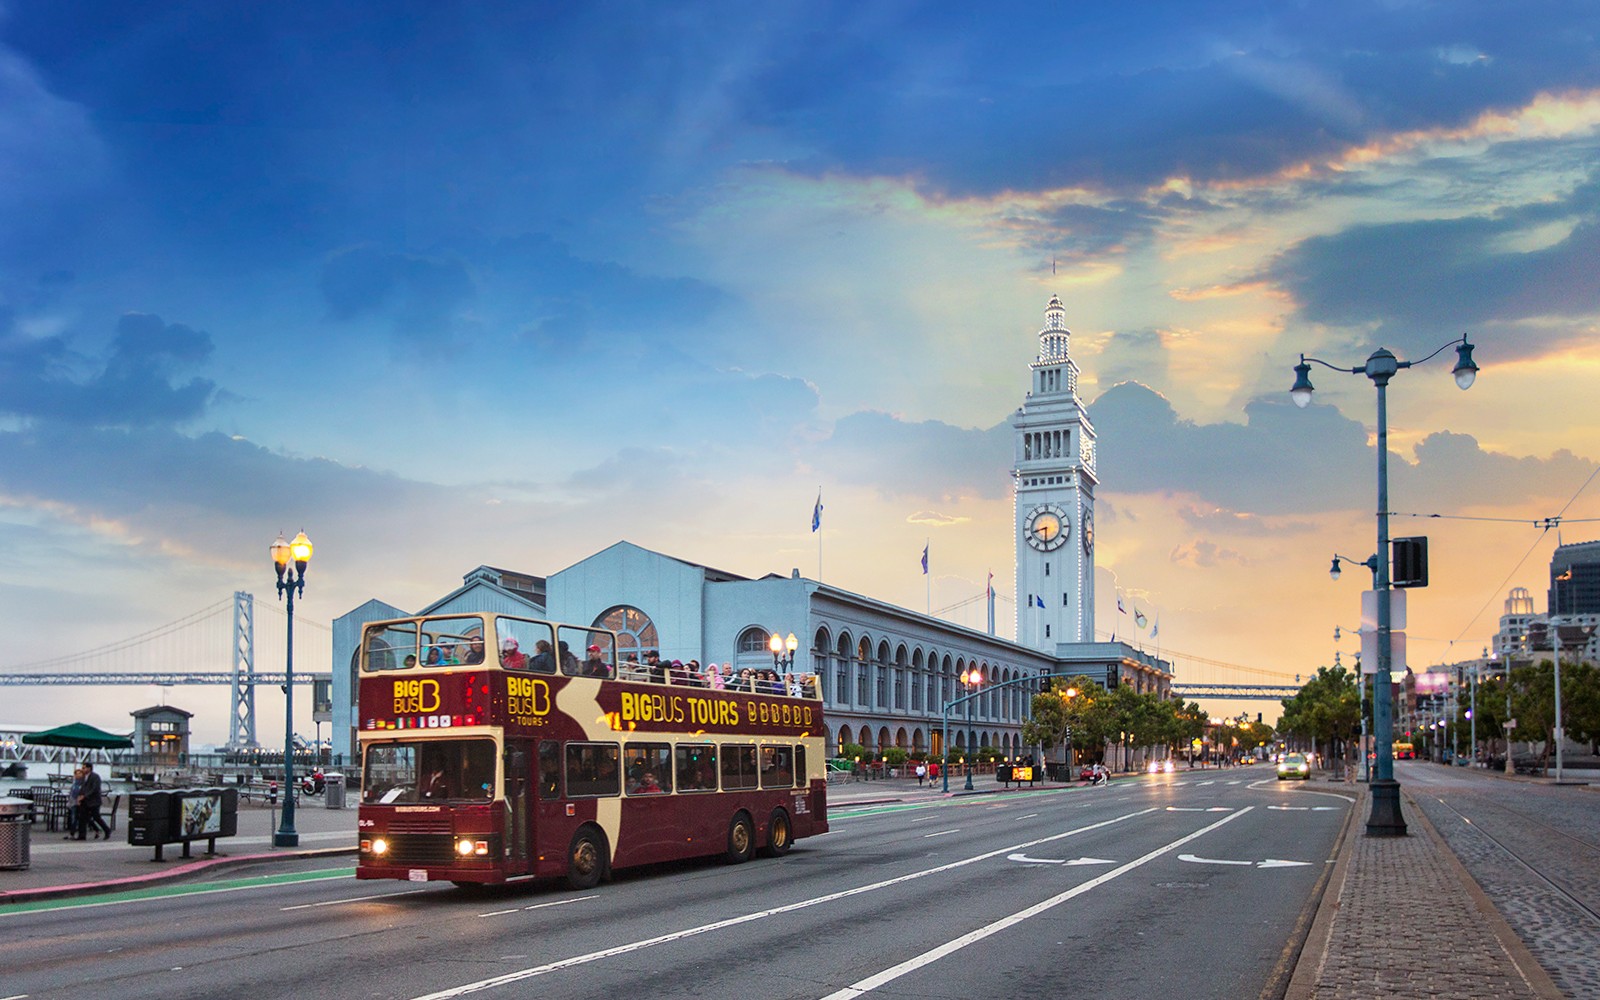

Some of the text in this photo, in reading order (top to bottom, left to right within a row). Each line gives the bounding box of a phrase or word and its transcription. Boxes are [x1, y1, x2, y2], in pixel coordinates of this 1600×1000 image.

[393, 680, 419, 698] BIG
[507, 676, 532, 698] BIG
[394, 697, 419, 714] BUS
[508, 697, 533, 716] BUS
[687, 697, 740, 726] TOURS
[516, 716, 544, 727] TOURS
